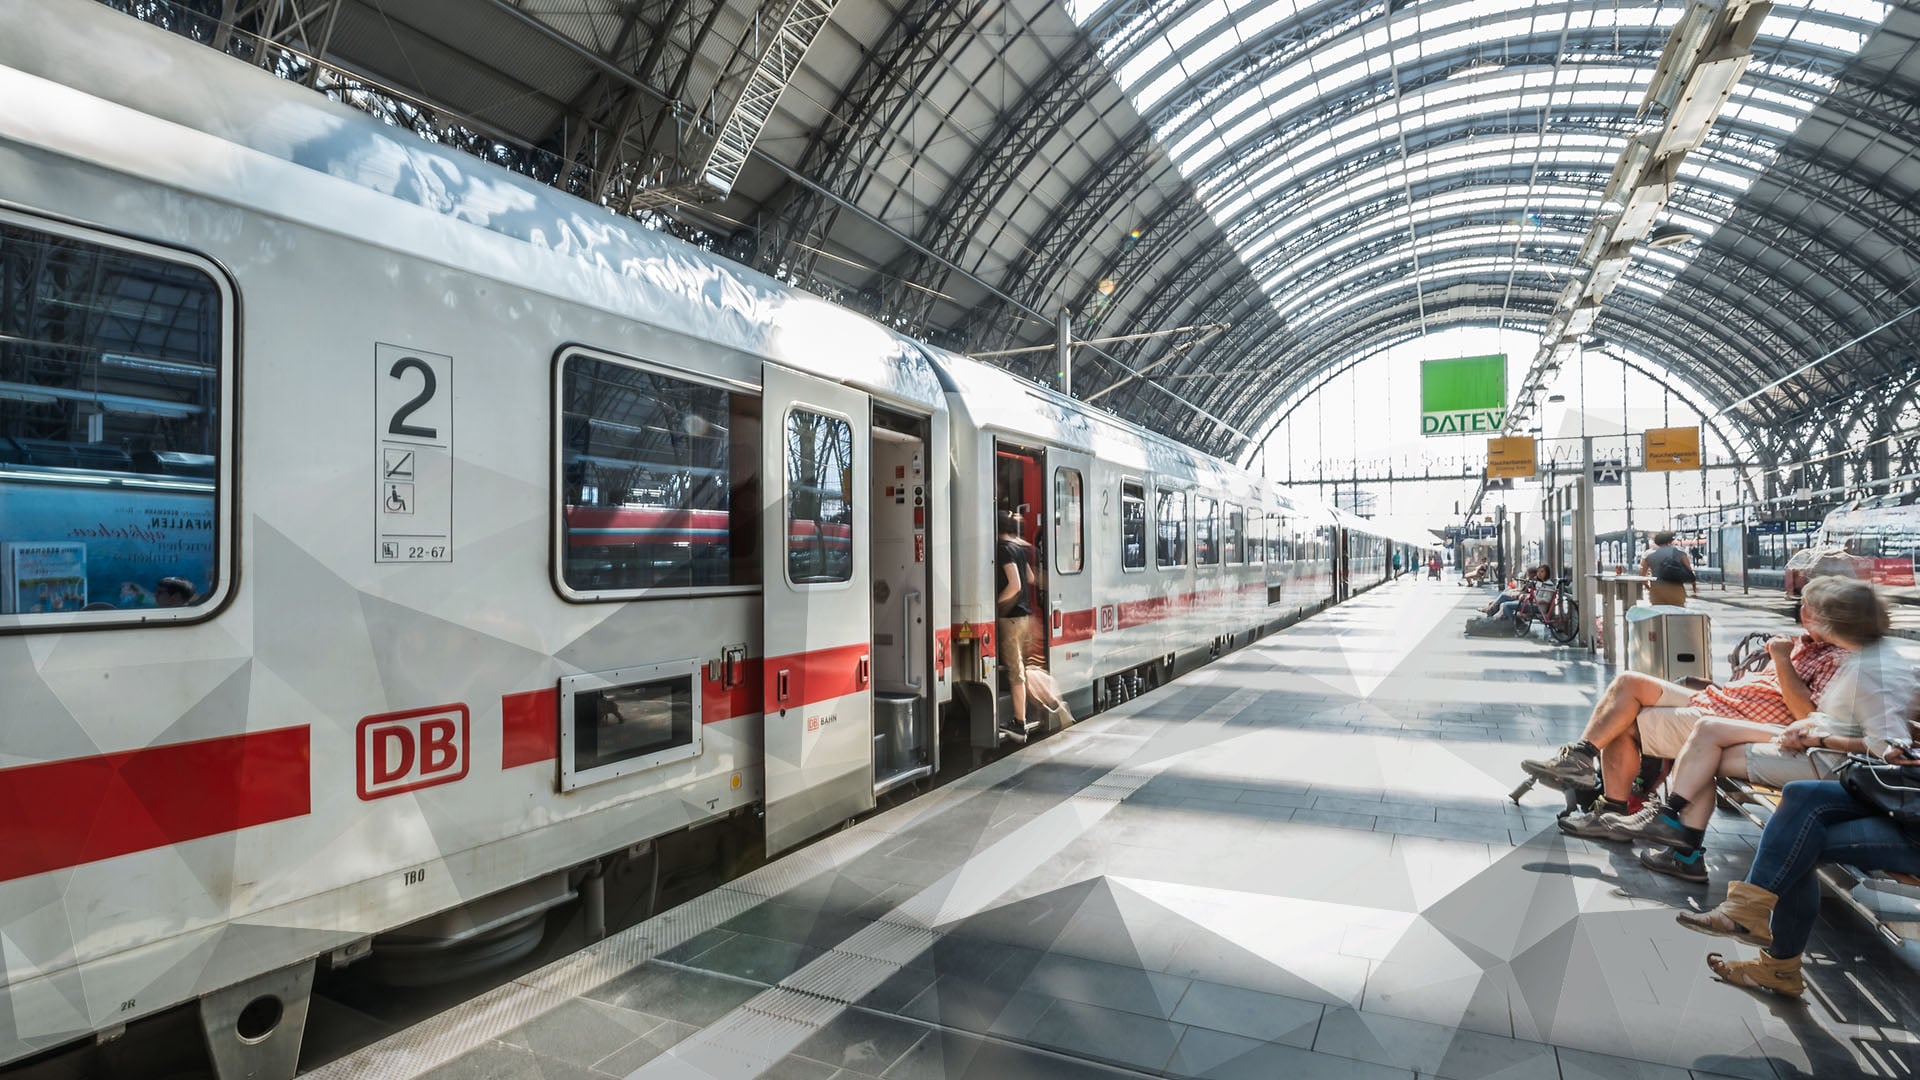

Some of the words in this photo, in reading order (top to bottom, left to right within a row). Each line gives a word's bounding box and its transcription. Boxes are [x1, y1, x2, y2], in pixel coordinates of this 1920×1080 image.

[388, 356, 437, 439] 2
[1422, 411, 1506, 433] DATEV
[1600, 462, 1619, 482] A
[1102, 488, 1109, 517] 2
[408, 546, 446, 559] 22-67
[1102, 607, 1113, 630] DB
[808, 717, 819, 730] DB
[820, 713, 837, 726] BAHN
[371, 716, 459, 787] DB
[120, 998, 137, 1012] 2R
